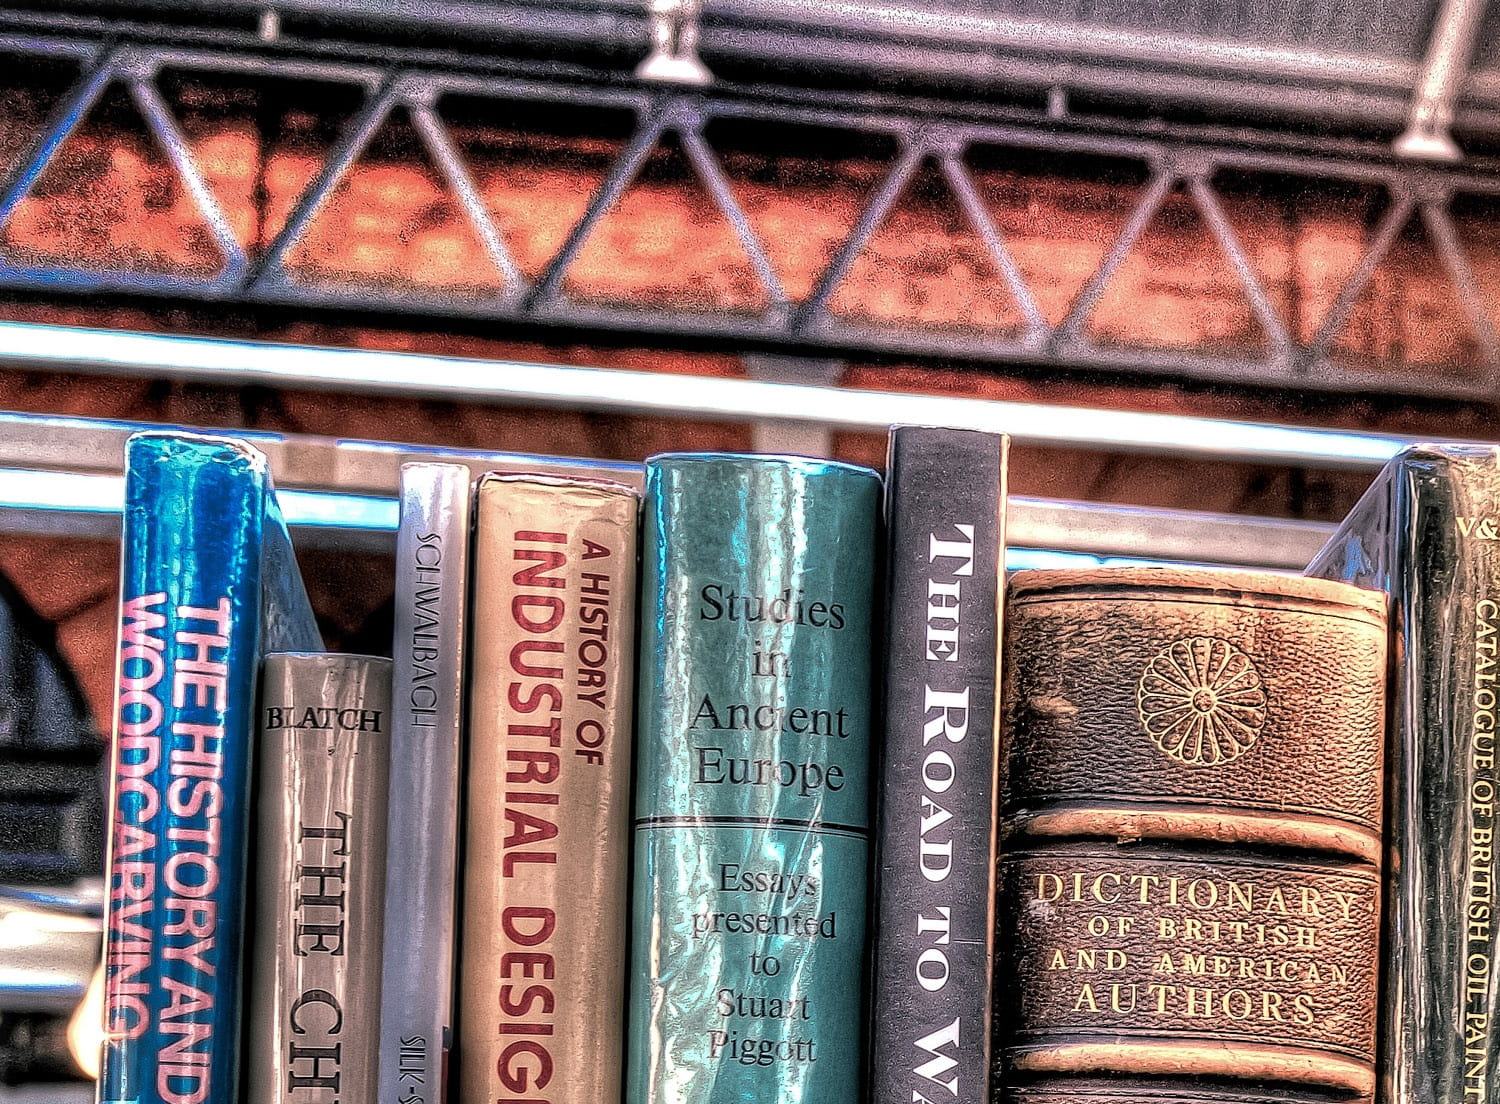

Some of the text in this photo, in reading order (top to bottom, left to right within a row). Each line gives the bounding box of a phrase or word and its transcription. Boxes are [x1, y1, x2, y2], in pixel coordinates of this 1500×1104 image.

[700, 584, 846, 630] Studies
[926, 523, 975, 662] THE
[410, 532, 443, 728] SCHWALBACH
[573, 539, 611, 767] A HISTORY OF
[172, 597, 231, 714] THE
[751, 640, 793, 678] in
[501, 530, 568, 879] INDUSTRIAL
[1472, 600, 1500, 770] CATALOGUE
[265, 705, 382, 733] BLATCH
[690, 693, 850, 739] Ancient
[693, 747, 845, 797] Europe
[920, 684, 970, 883] ROAD
[105, 591, 167, 1043] WOODCARVING
[1470, 780, 1494, 818] OF
[161, 721, 225, 977] HISTORY
[294, 811, 353, 958] THE
[718, 863, 817, 900] Essays
[1035, 872, 1358, 922] DICTIONARY
[1467, 827, 1494, 943] BRITISH
[692, 910, 837, 940] presented
[915, 906, 951, 992] TO
[1087, 915, 1319, 949] OF BRITISH
[750, 951, 781, 977] to
[1050, 949, 1349, 985] AND AMERICAN
[1465, 953, 1490, 1002] OIL
[717, 987, 810, 1021] Stuart
[1070, 983, 1315, 1026] AUTHORS
[706, 1030, 817, 1067] Piggott
